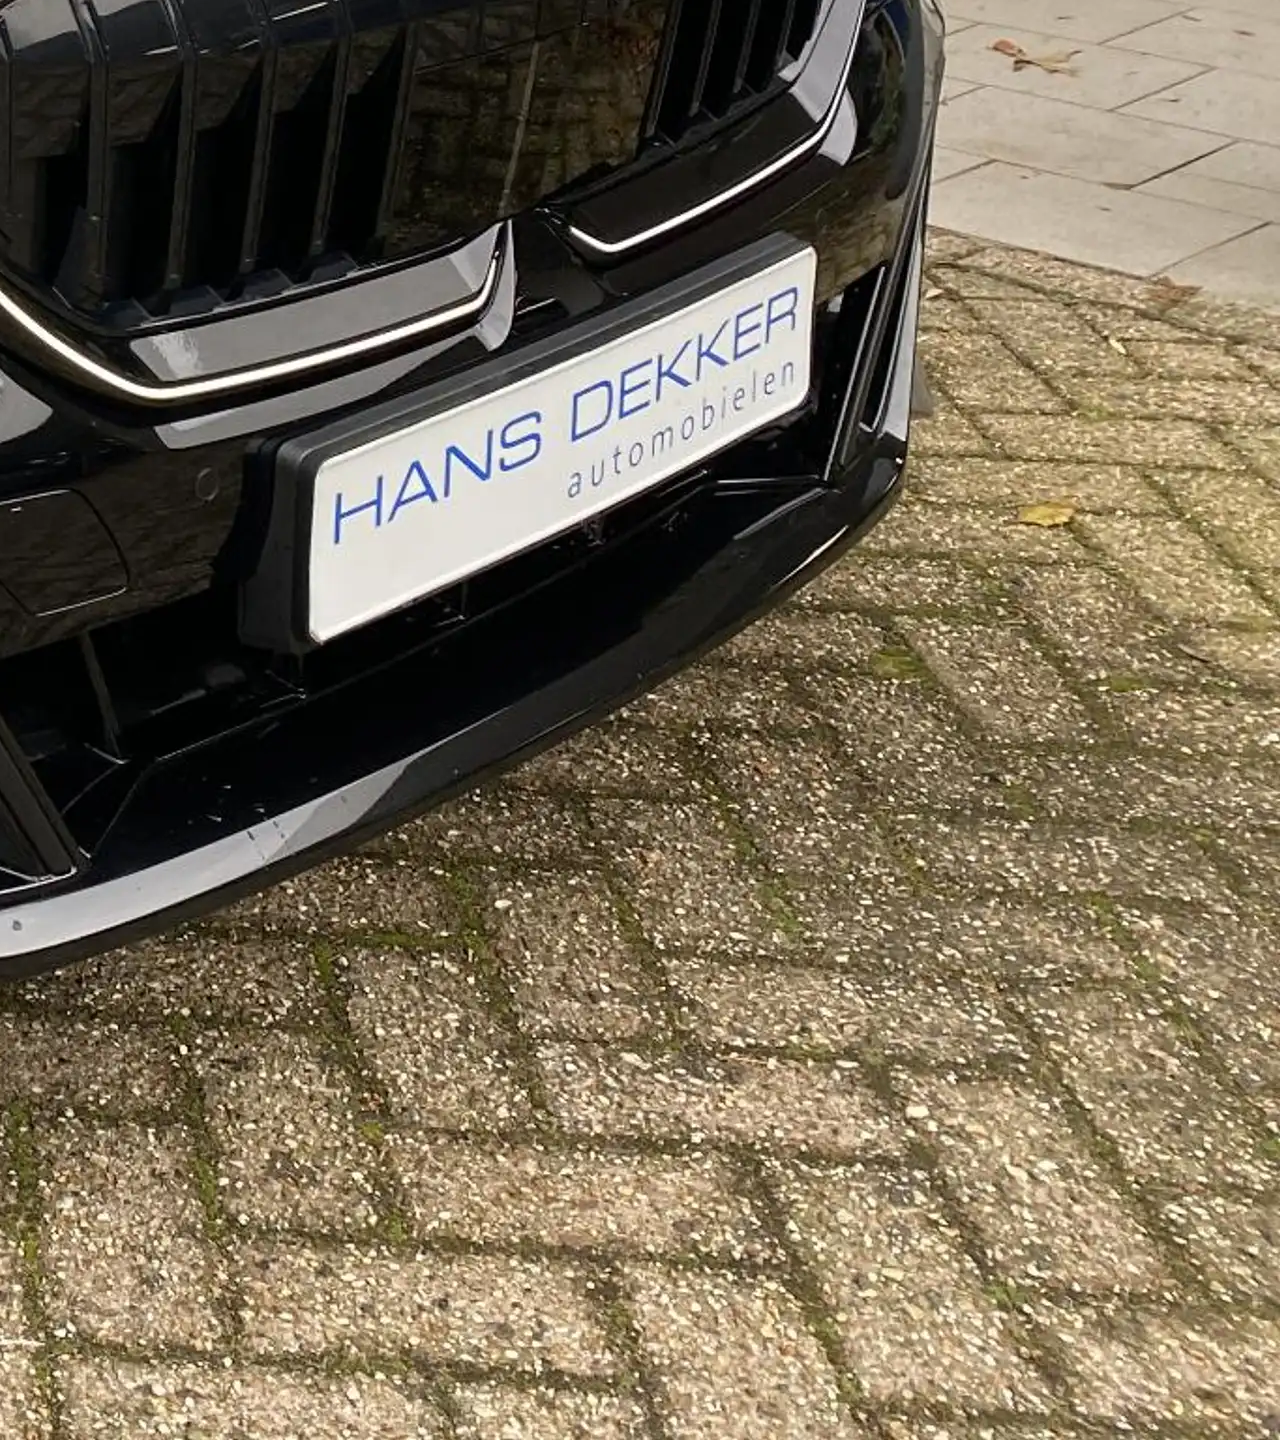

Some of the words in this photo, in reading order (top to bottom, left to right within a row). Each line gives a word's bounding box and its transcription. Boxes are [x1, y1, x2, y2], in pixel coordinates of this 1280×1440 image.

[333, 410, 543, 545] HANS
[570, 286, 800, 443] DEKKER
[566, 360, 796, 499] automobielen
